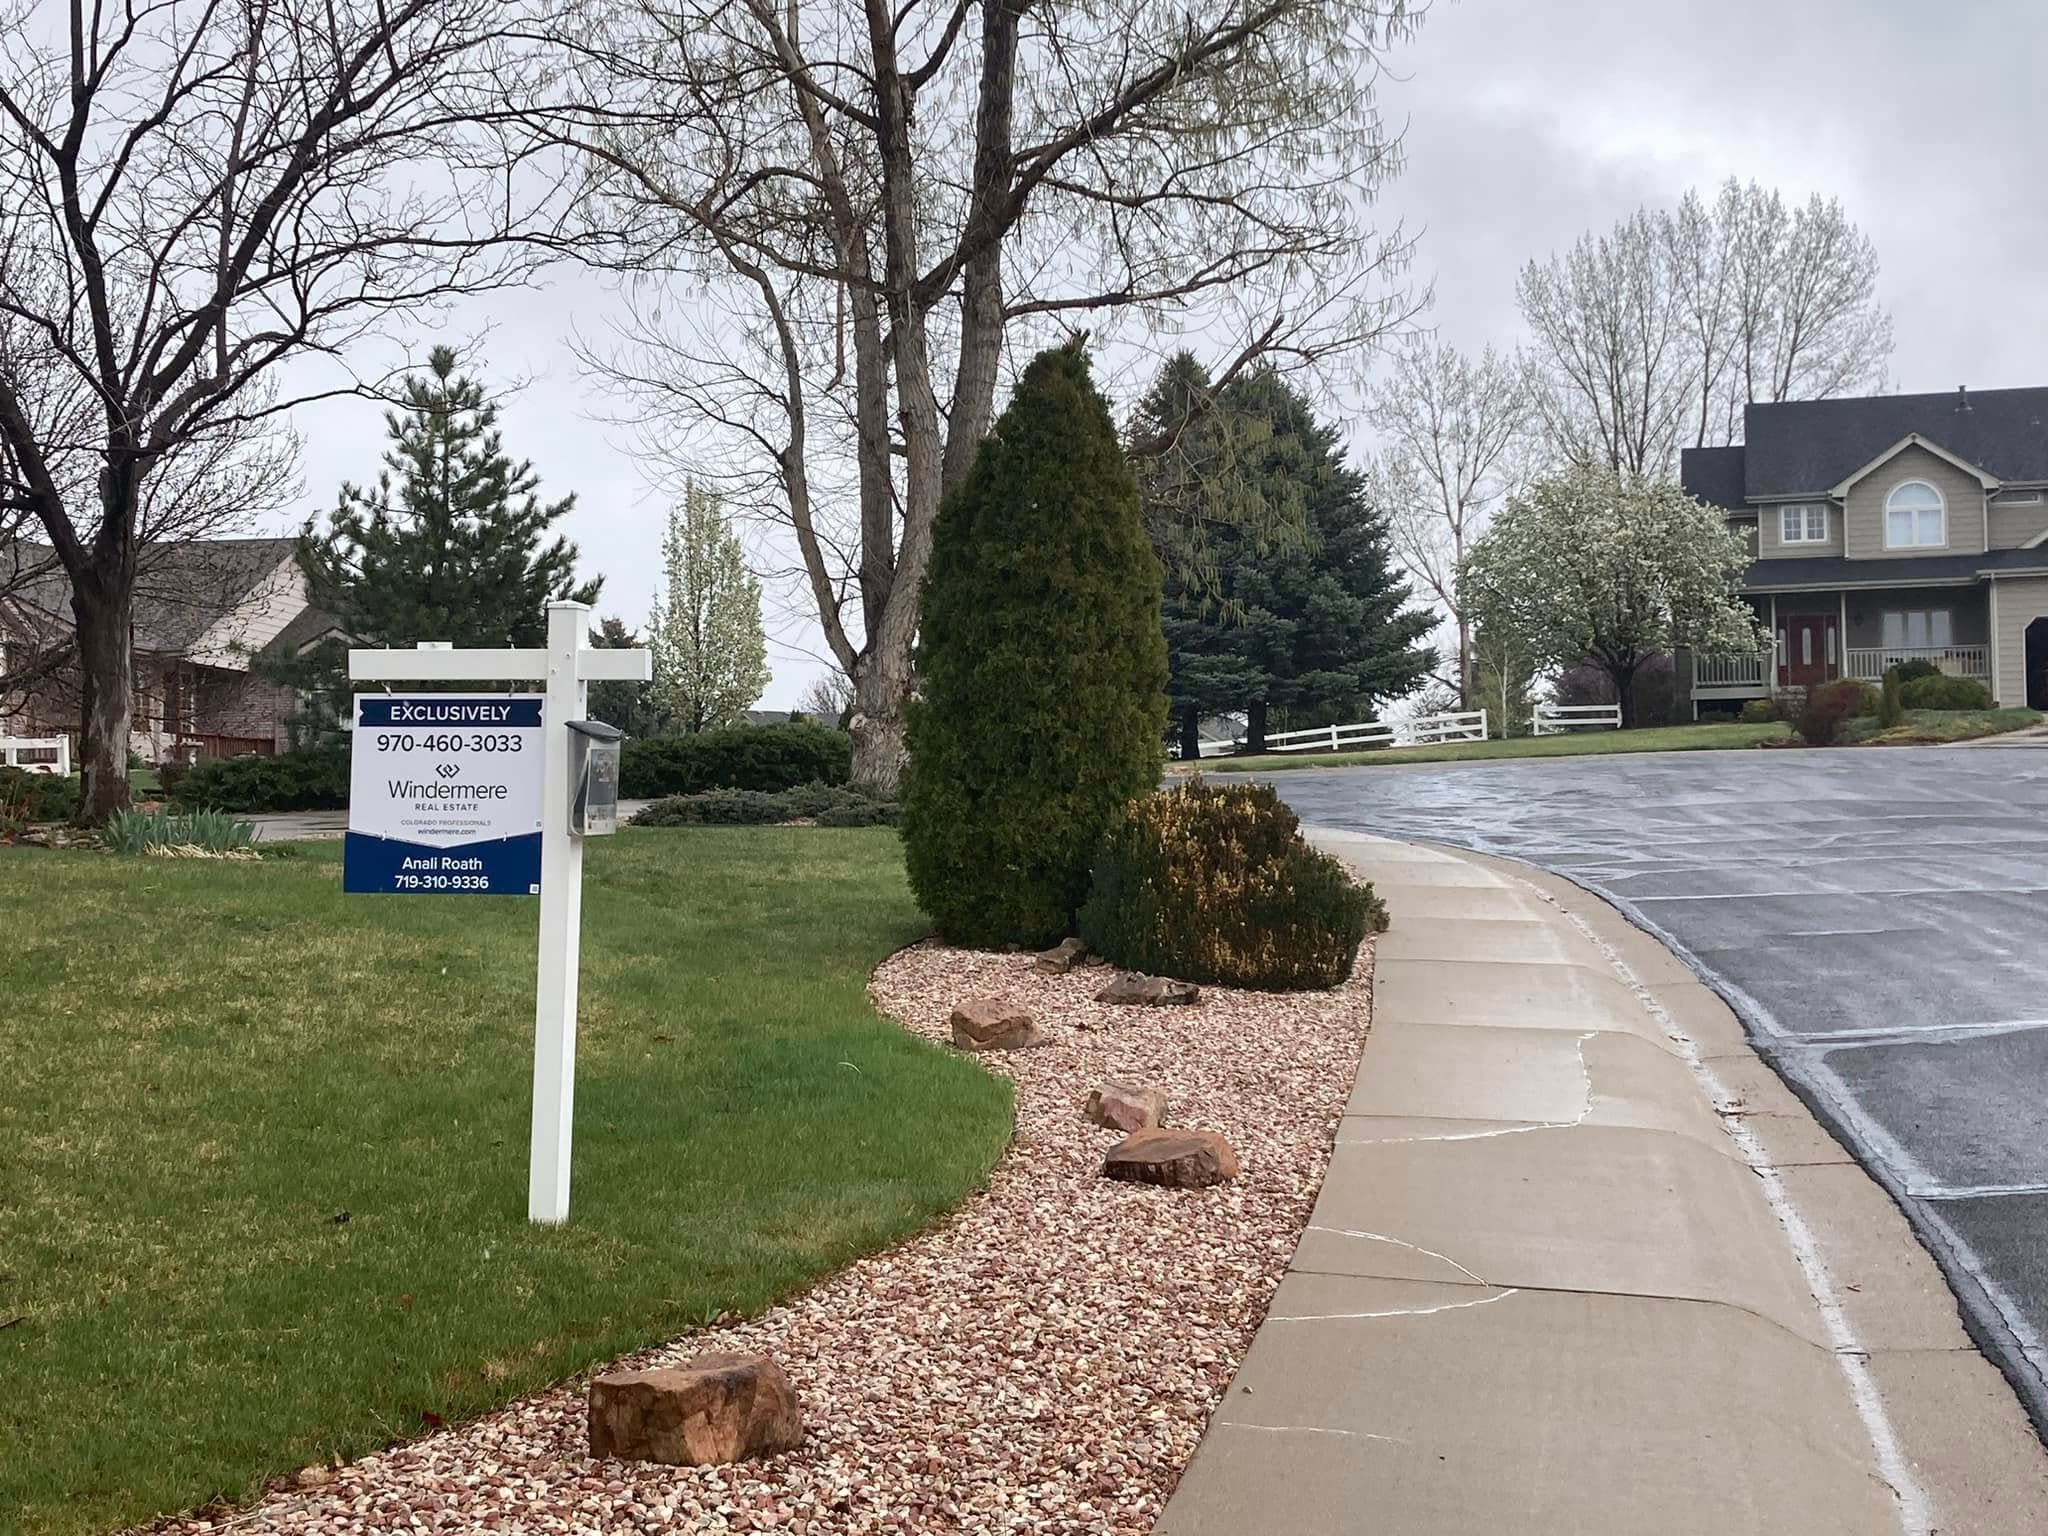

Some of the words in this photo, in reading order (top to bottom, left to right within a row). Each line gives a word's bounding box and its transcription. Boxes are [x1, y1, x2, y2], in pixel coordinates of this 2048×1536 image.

[390, 706, 511, 721] EXCLUSIVELY
[377, 734, 522, 752] 970-460-3033
[388, 780, 508, 799] Windermere
[415, 803, 439, 811] REAL
[443, 803, 479, 811] ESTATE
[402, 857, 438, 870] Anali
[441, 857, 482, 870] Roath
[395, 875, 489, 889] 719-310-9336
